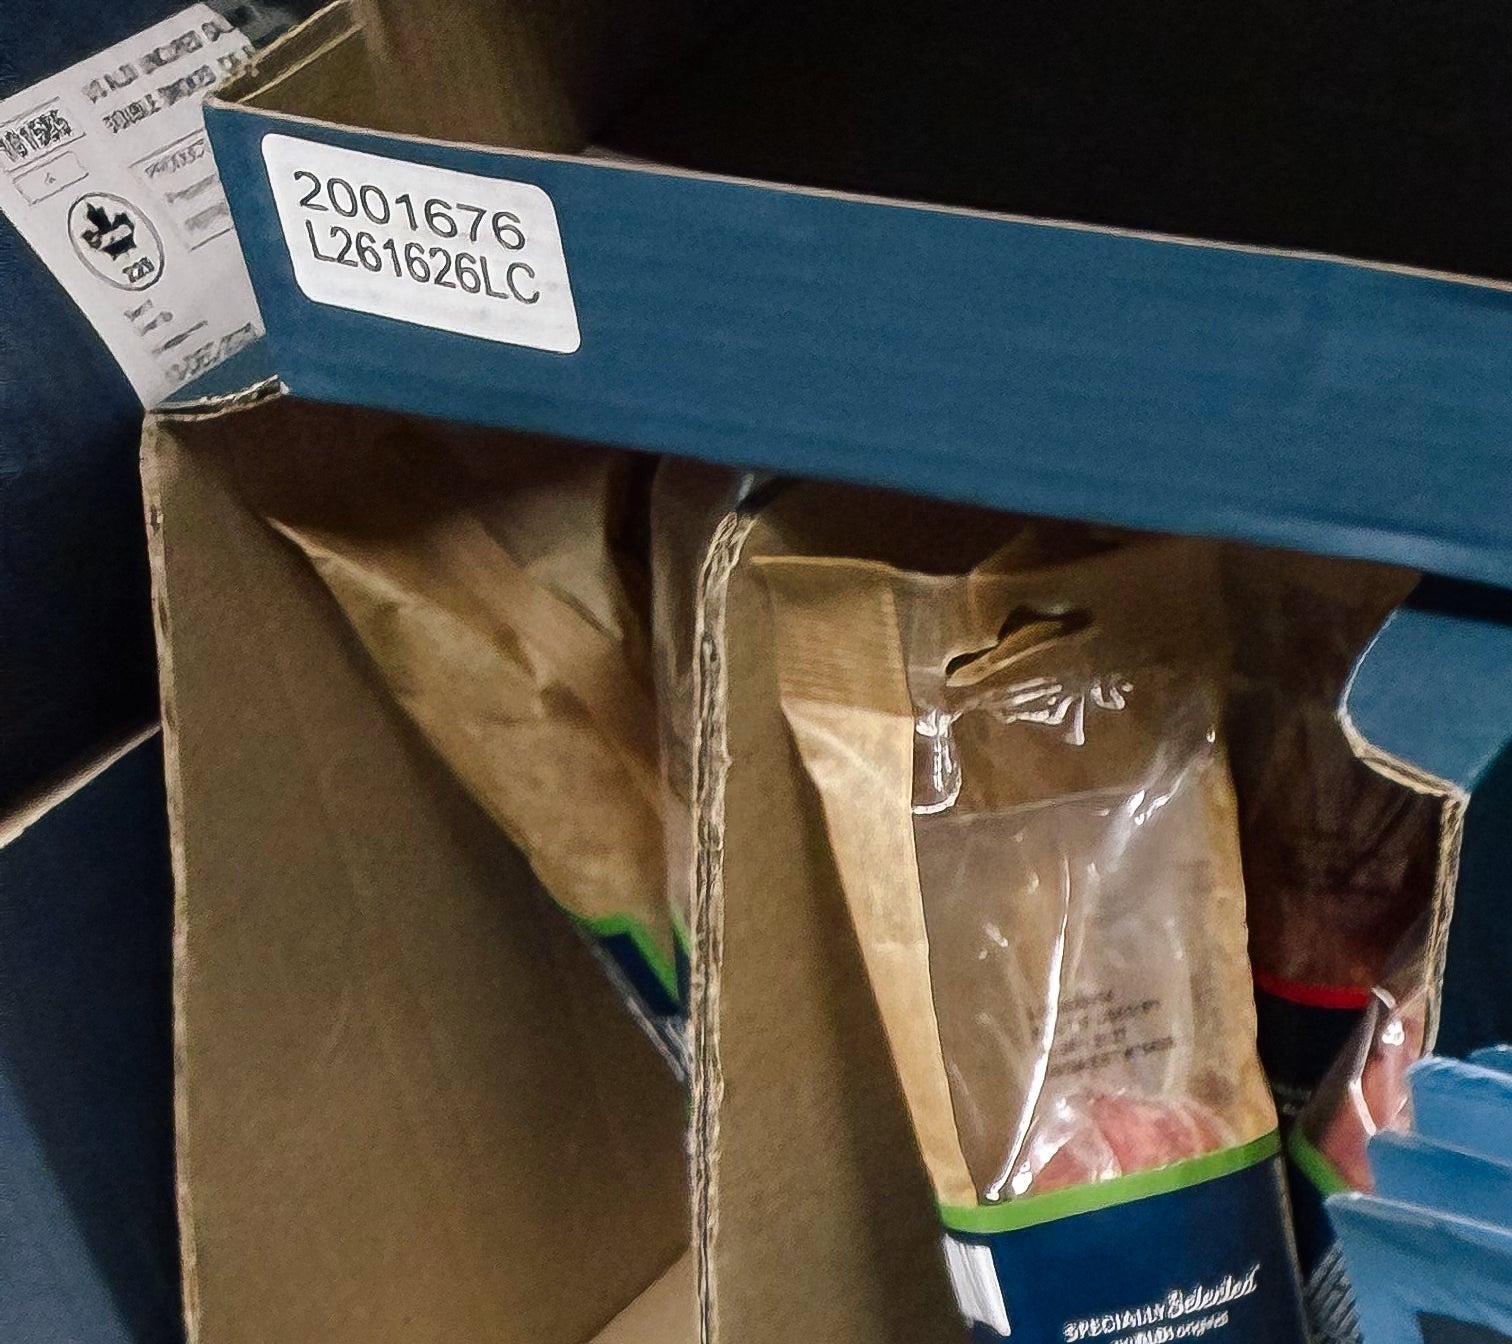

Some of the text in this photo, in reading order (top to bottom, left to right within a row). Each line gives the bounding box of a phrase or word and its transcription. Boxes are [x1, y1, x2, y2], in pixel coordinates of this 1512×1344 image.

[293, 169, 527, 252] 2001676
[305, 218, 541, 305] L261626LC
[1063, 1263, 1260, 1343] SPECIALLY Selected
